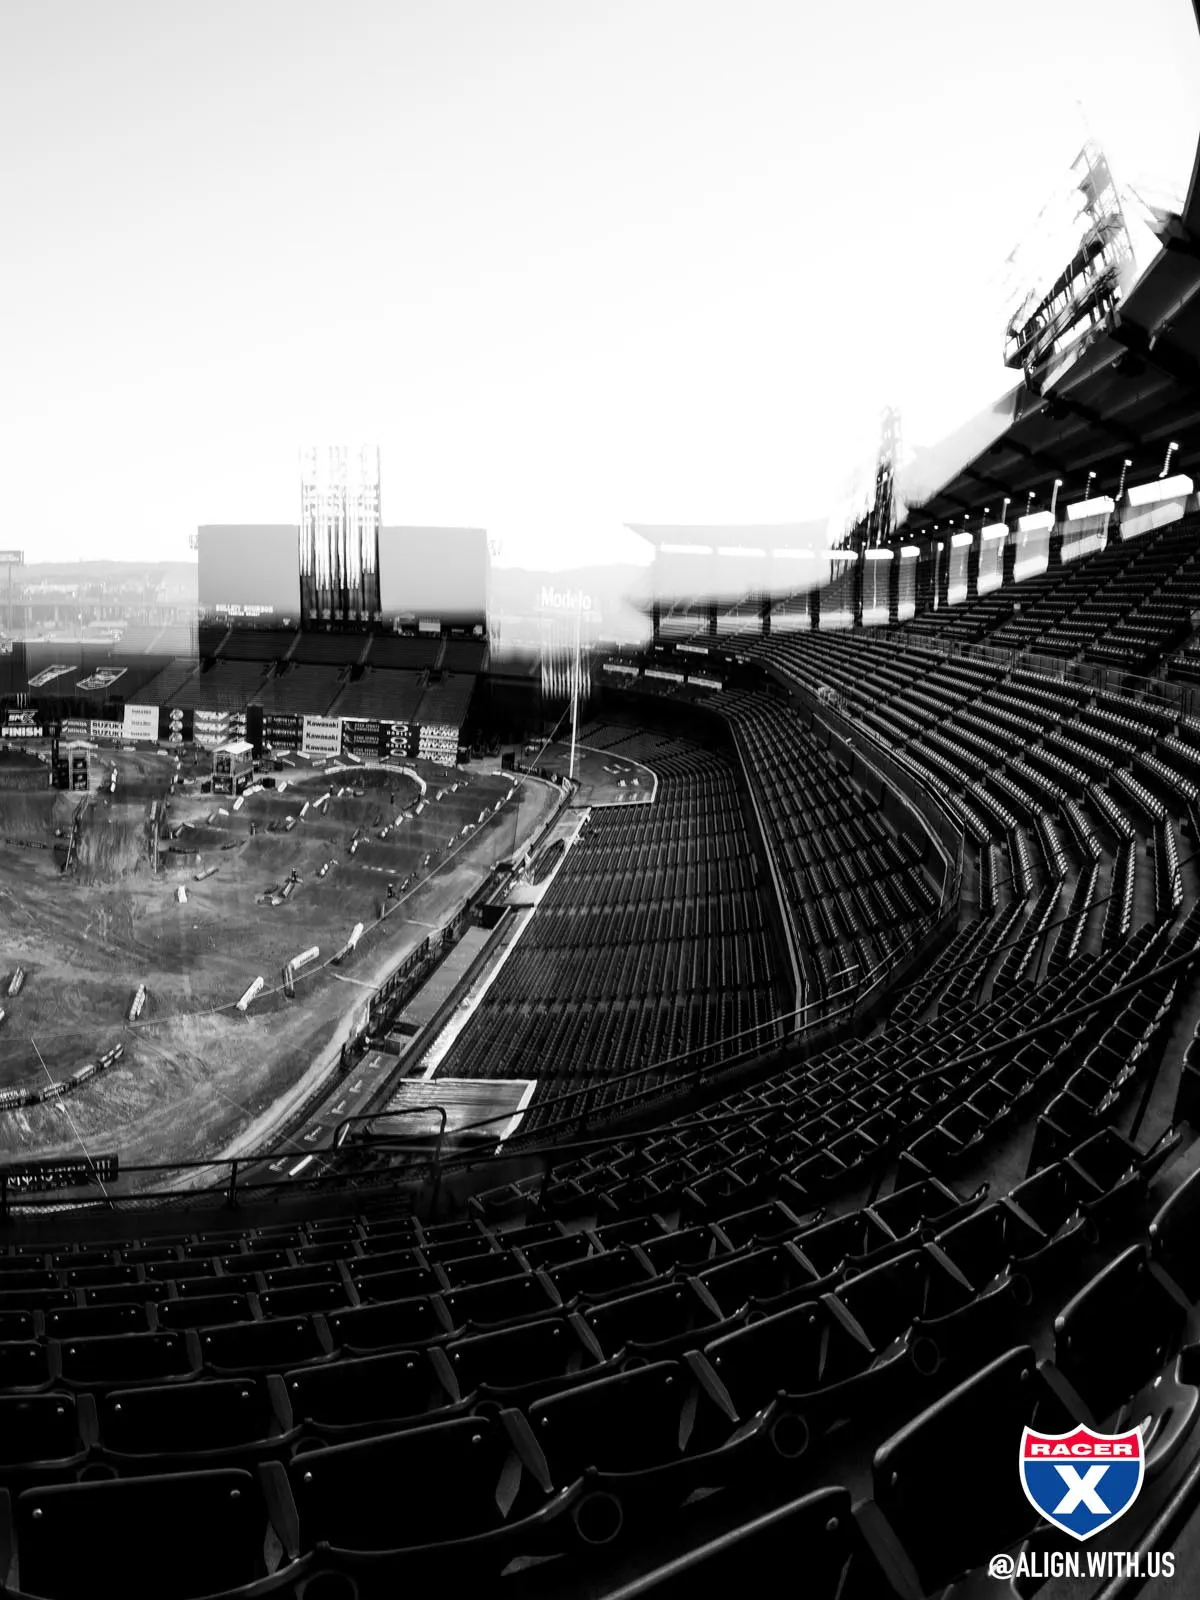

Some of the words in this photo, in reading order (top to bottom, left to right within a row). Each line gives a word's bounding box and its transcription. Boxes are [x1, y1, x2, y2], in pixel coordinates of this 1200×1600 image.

[541, 586, 591, 610] Modelo
[306, 720, 339, 729] Kawasaki
[1, 727, 43, 738] FINISH
[306, 732, 338, 741] Kawasaki
